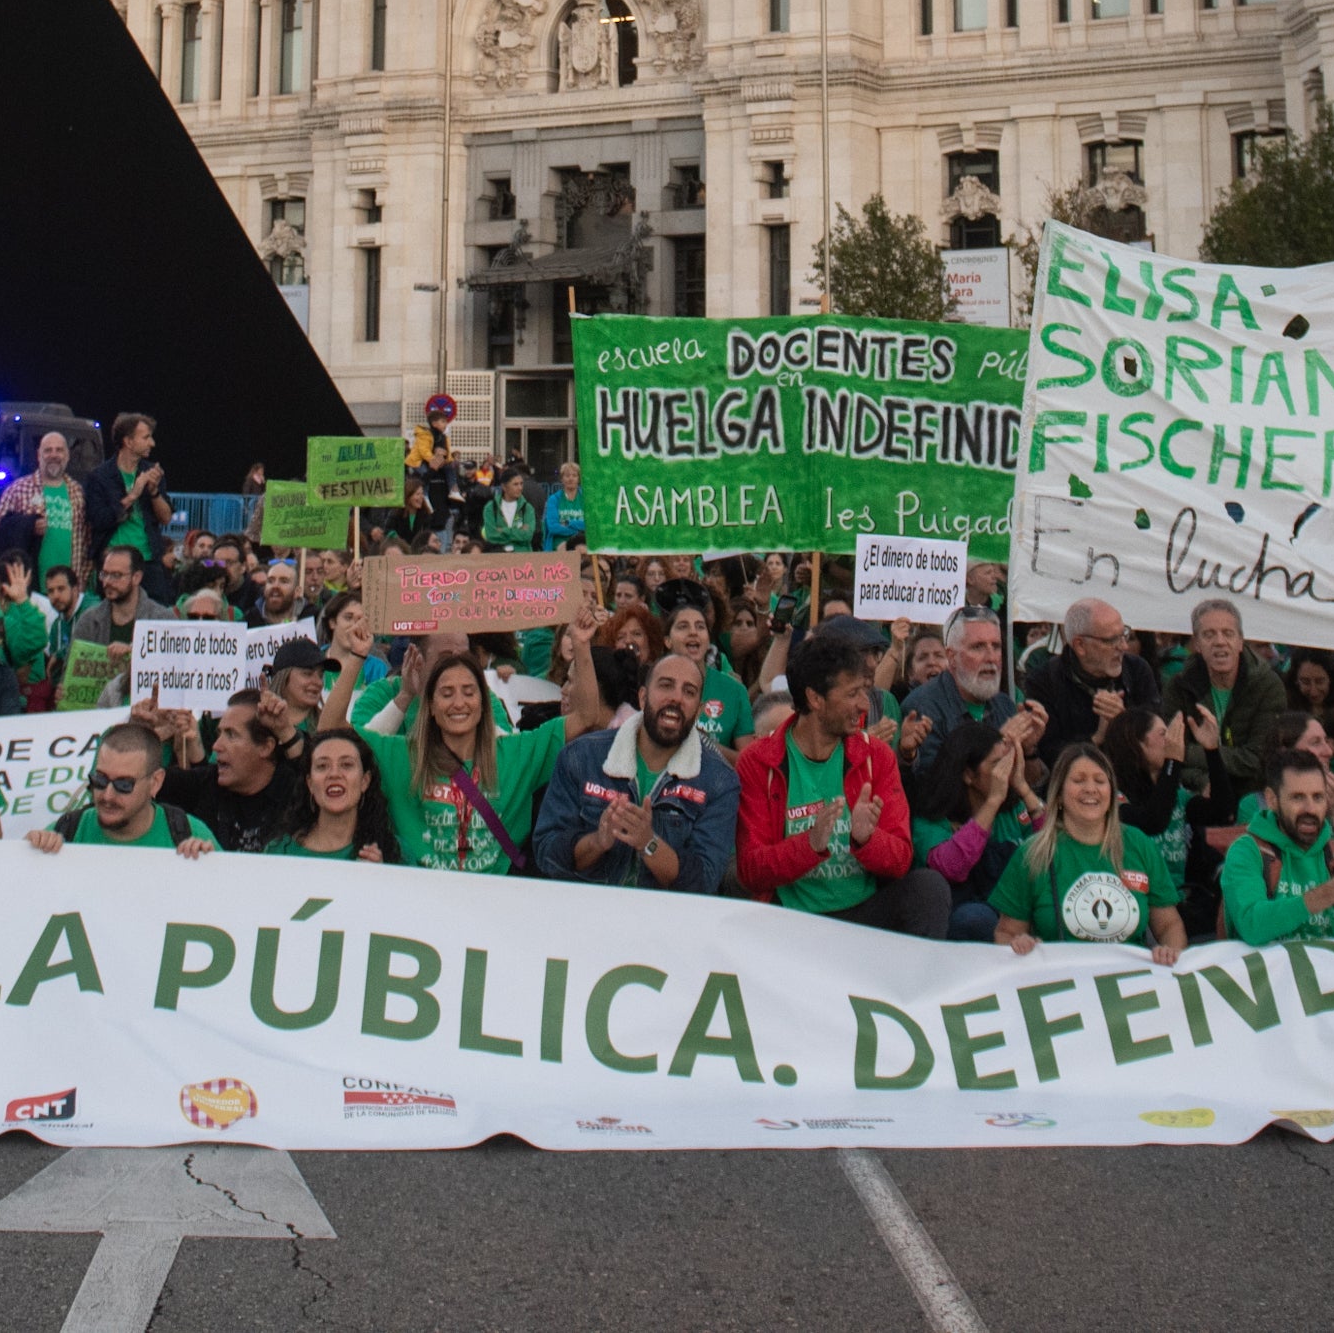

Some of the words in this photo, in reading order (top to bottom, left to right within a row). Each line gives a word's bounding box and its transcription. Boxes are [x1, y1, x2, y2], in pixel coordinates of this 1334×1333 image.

[1046, 233, 1261, 332] ELISA
[597, 338, 706, 373] escuela
[729, 328, 955, 380] DOCENTES
[977, 350, 1029, 380] púb
[777, 370, 807, 387] en
[598, 388, 782, 458] HUELGA
[805, 390, 1023, 470] INDEFINID
[337, 442, 377, 463] AULA
[321, 477, 393, 500] FESTIVAL
[615, 484, 784, 527] ASAMBLEA
[896, 489, 1015, 543] Puigad
[1032, 495, 1120, 587] En
[863, 544, 879, 572] ¿El
[882, 545, 913, 569] dinero
[916, 547, 927, 570] de
[930, 549, 958, 573] todos
[401, 566, 468, 586] PIERDO
[475, 570, 508, 583] CADA
[513, 565, 535, 581] DÍA
[543, 565, 570, 581] MÁS
[402, 592, 419, 603] DE
[474, 589, 498, 602] POR
[505, 589, 564, 603] DEFENDER
[860, 583, 880, 605] para
[882, 579, 916, 603] educar
[918, 585, 925, 603] a
[927, 582, 959, 606] ricos?
[433, 608, 449, 619] LO
[458, 606, 483, 618] QUE
[490, 603, 514, 617] MÁS
[522, 605, 556, 617] CREO
[394, 622, 413, 631] UGT
[140, 629, 157, 659] ¿El
[160, 630, 191, 654] dinero
[194, 631, 206, 654] de
[209, 632, 237, 655] todos
[137, 669, 159, 694] para
[162, 666, 194, 689] educar
[197, 673, 203, 689] a
[206, 669, 239, 692] ricos?
[25, 765, 89, 788] EDU
[585, 782, 606, 795] UGT
[787, 808, 808, 820] UGT
[154, 896, 799, 1089] PÚBLICA.
[16, 1098, 67, 1119] CNT
